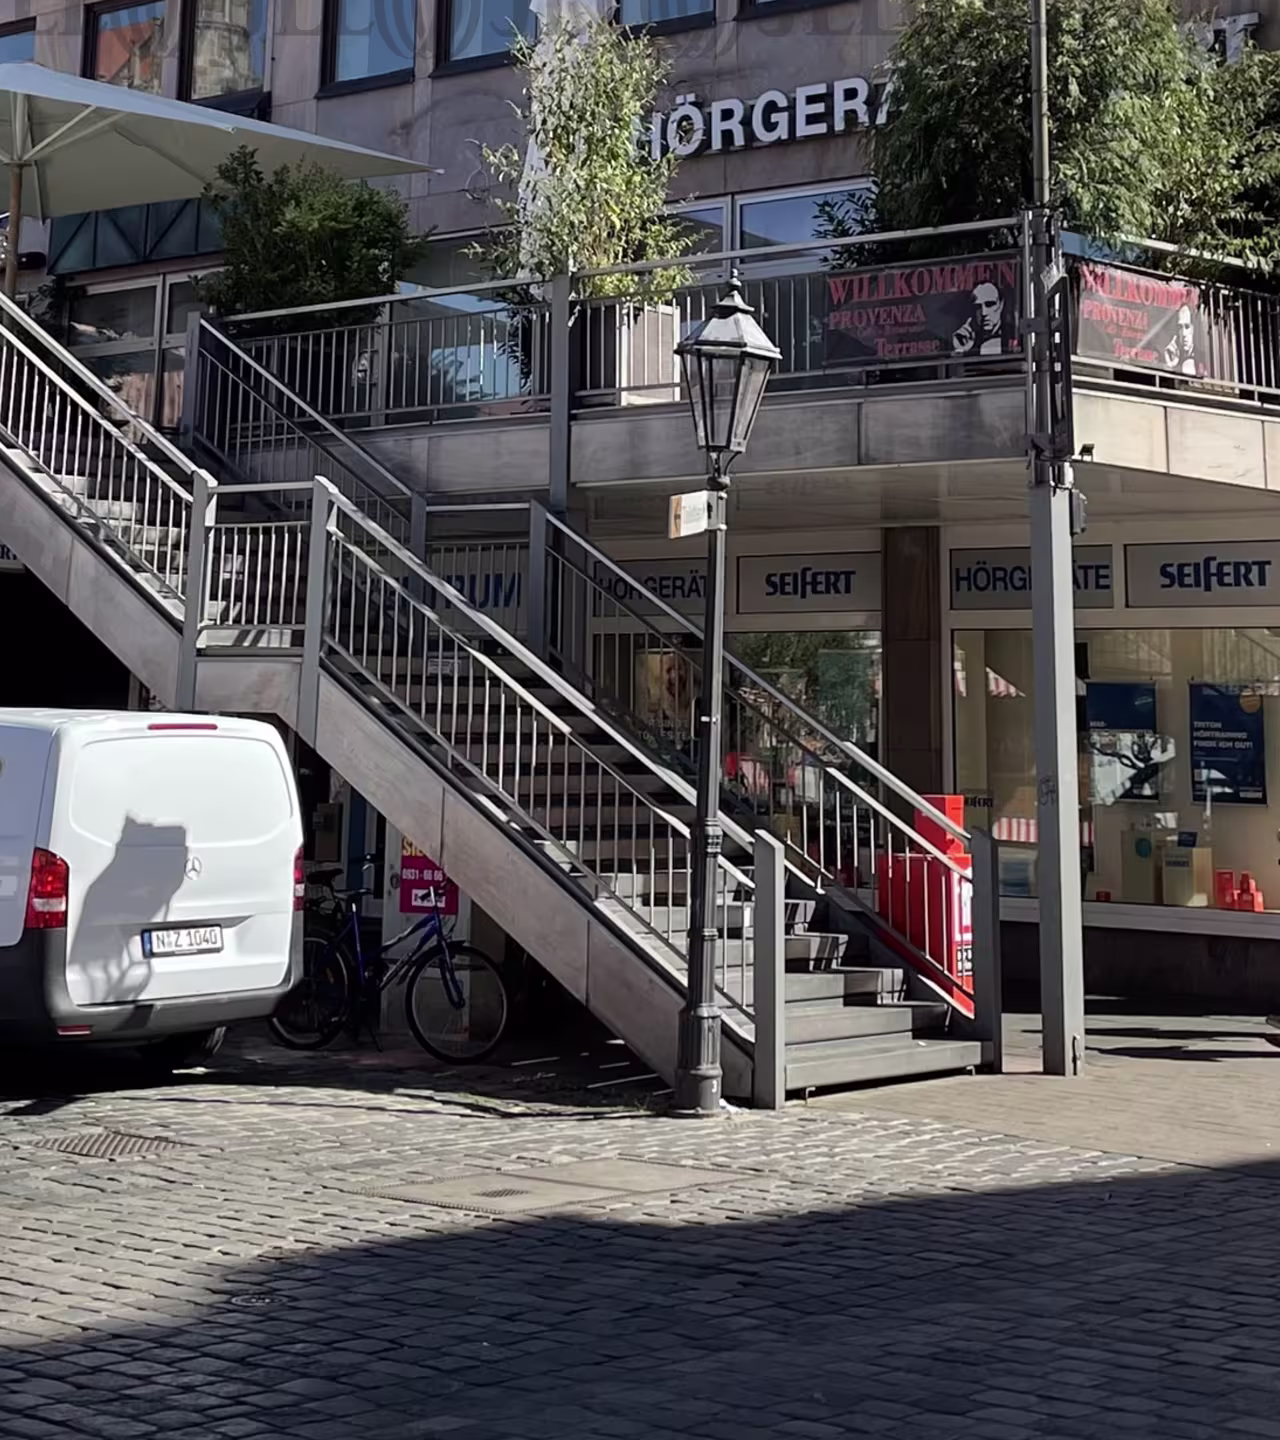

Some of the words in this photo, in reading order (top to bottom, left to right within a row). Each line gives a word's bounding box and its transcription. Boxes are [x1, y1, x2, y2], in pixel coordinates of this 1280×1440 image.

[829, 260, 1018, 305] WILLKOMMEN
[828, 303, 926, 330] PROVENZA
[874, 337, 941, 358] Terrasse
[186, 928, 218, 947] 1040
